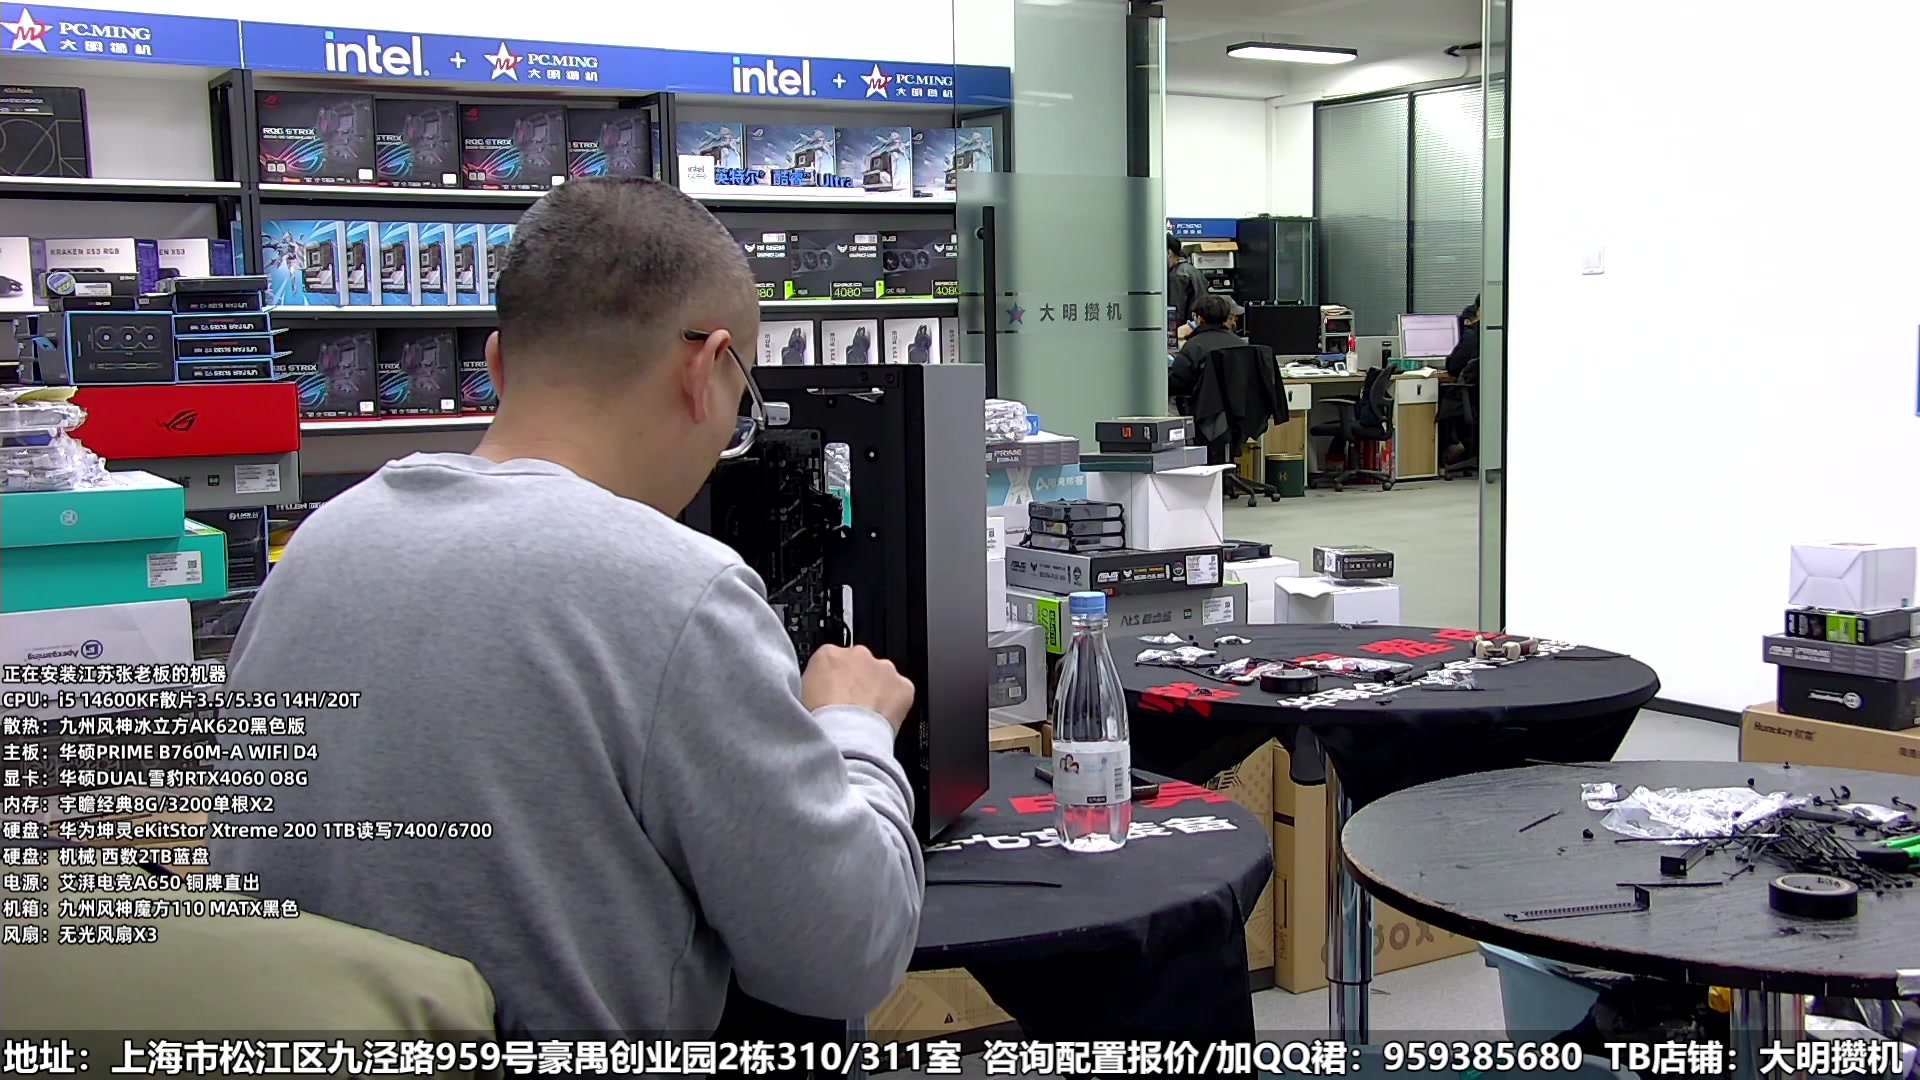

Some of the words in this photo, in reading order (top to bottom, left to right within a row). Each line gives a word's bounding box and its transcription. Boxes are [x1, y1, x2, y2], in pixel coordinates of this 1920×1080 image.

[817, 172, 854, 188] Ultra
[834, 287, 861, 298] 4080
[1039, 302, 1122, 322] 大明攒机
